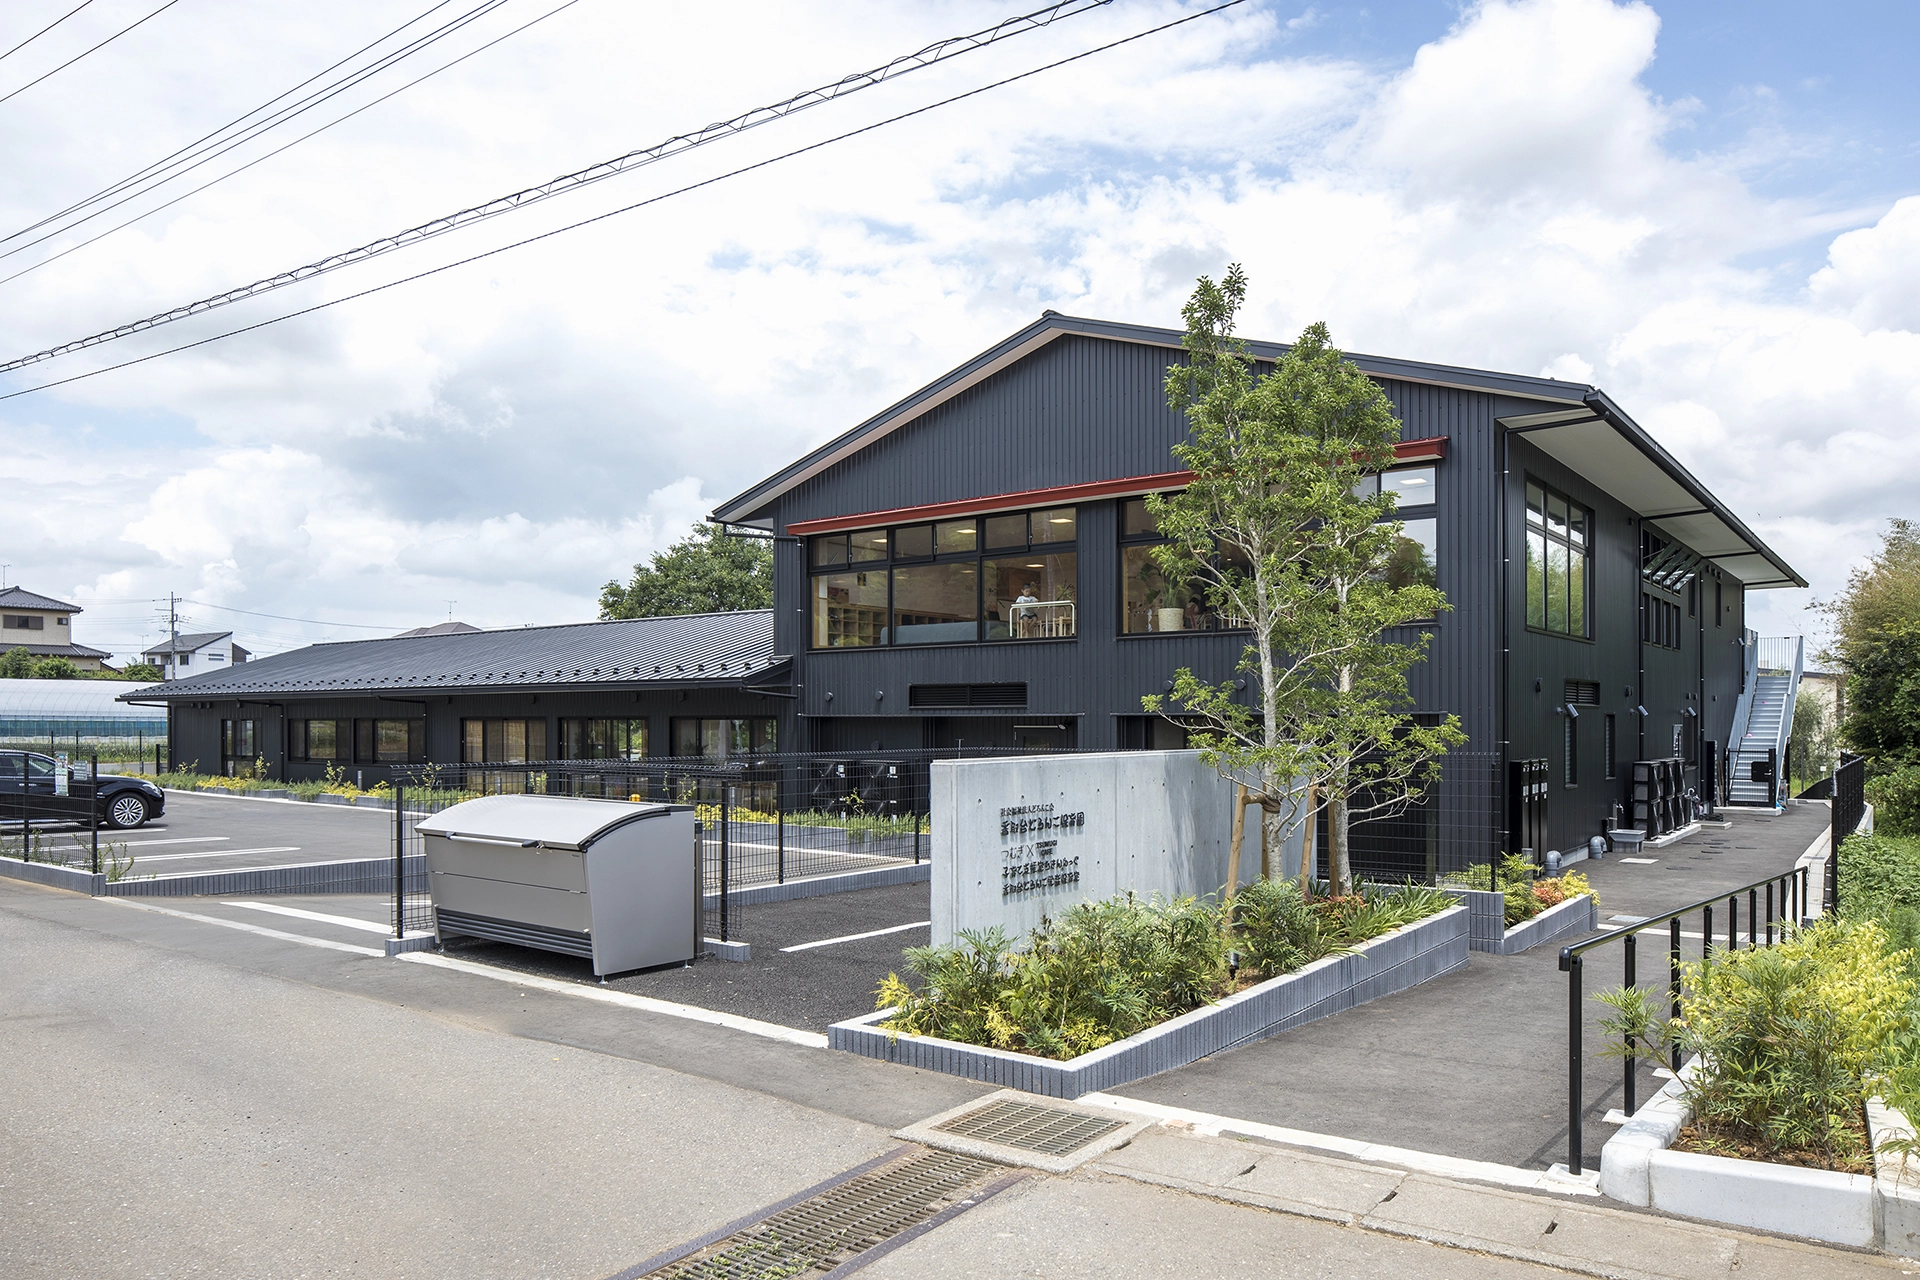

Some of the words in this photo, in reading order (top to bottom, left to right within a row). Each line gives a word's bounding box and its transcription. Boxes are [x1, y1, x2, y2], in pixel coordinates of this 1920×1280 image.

[1001, 844, 1024, 859] つむぎ
[1035, 840, 1057, 849] TSUMUGI
[1040, 848, 1053, 856] CAFE
